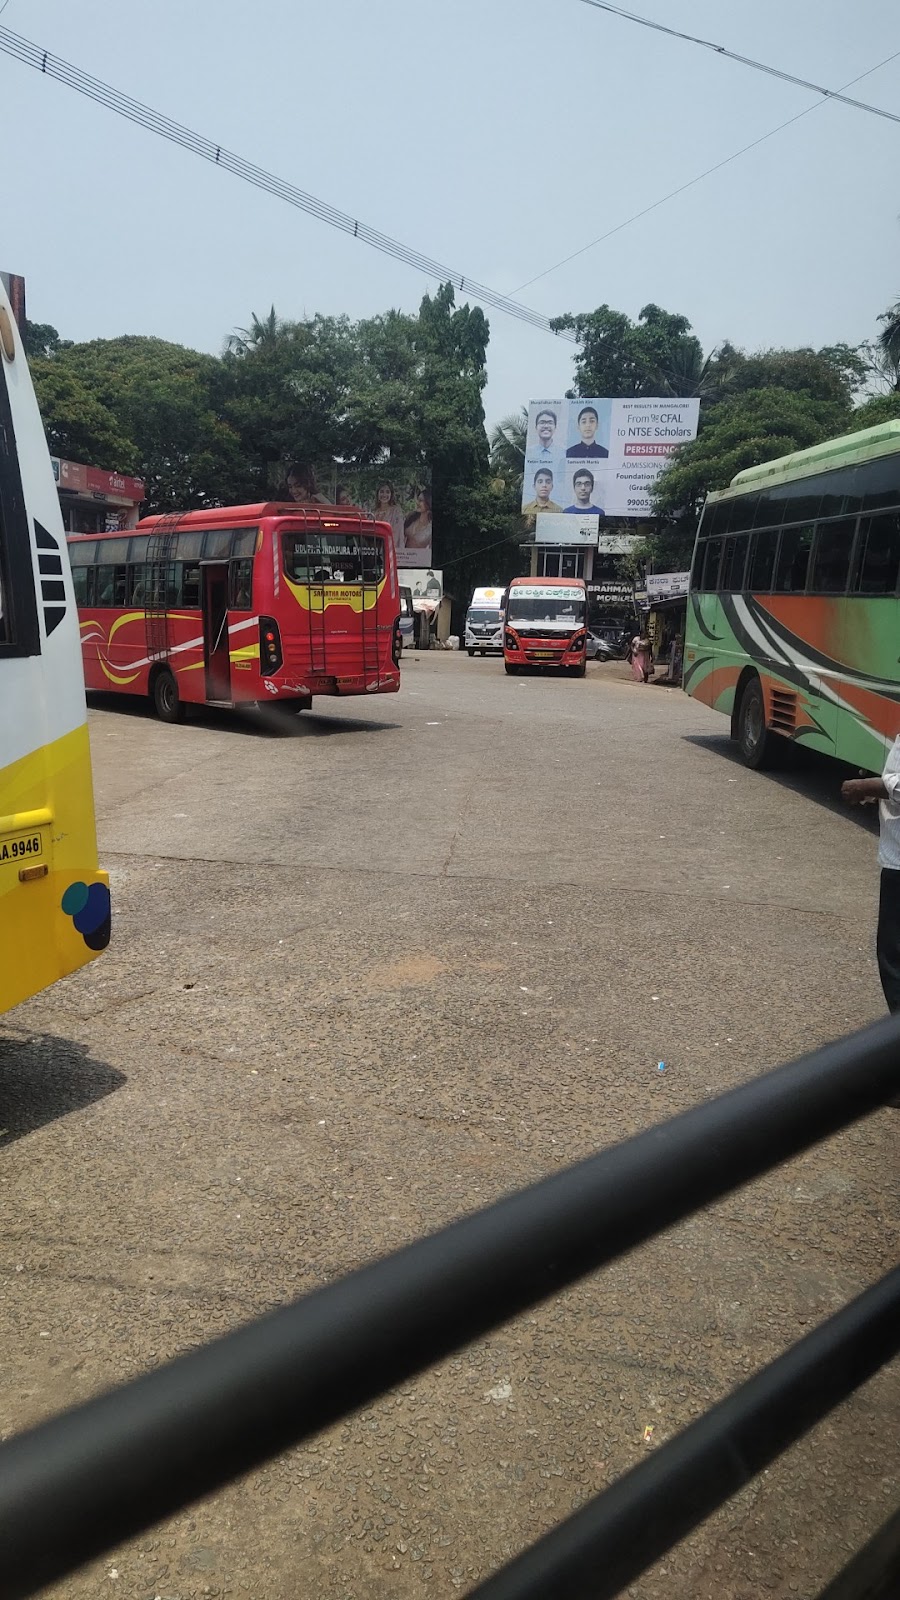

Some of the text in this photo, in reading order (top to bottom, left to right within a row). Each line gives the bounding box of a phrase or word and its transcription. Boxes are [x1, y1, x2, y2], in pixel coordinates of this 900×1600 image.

[627, 413, 683, 423] From CFAL
[617, 426, 692, 437] to NTSE Scholars
[626, 446, 678, 454] PERSISTENC
